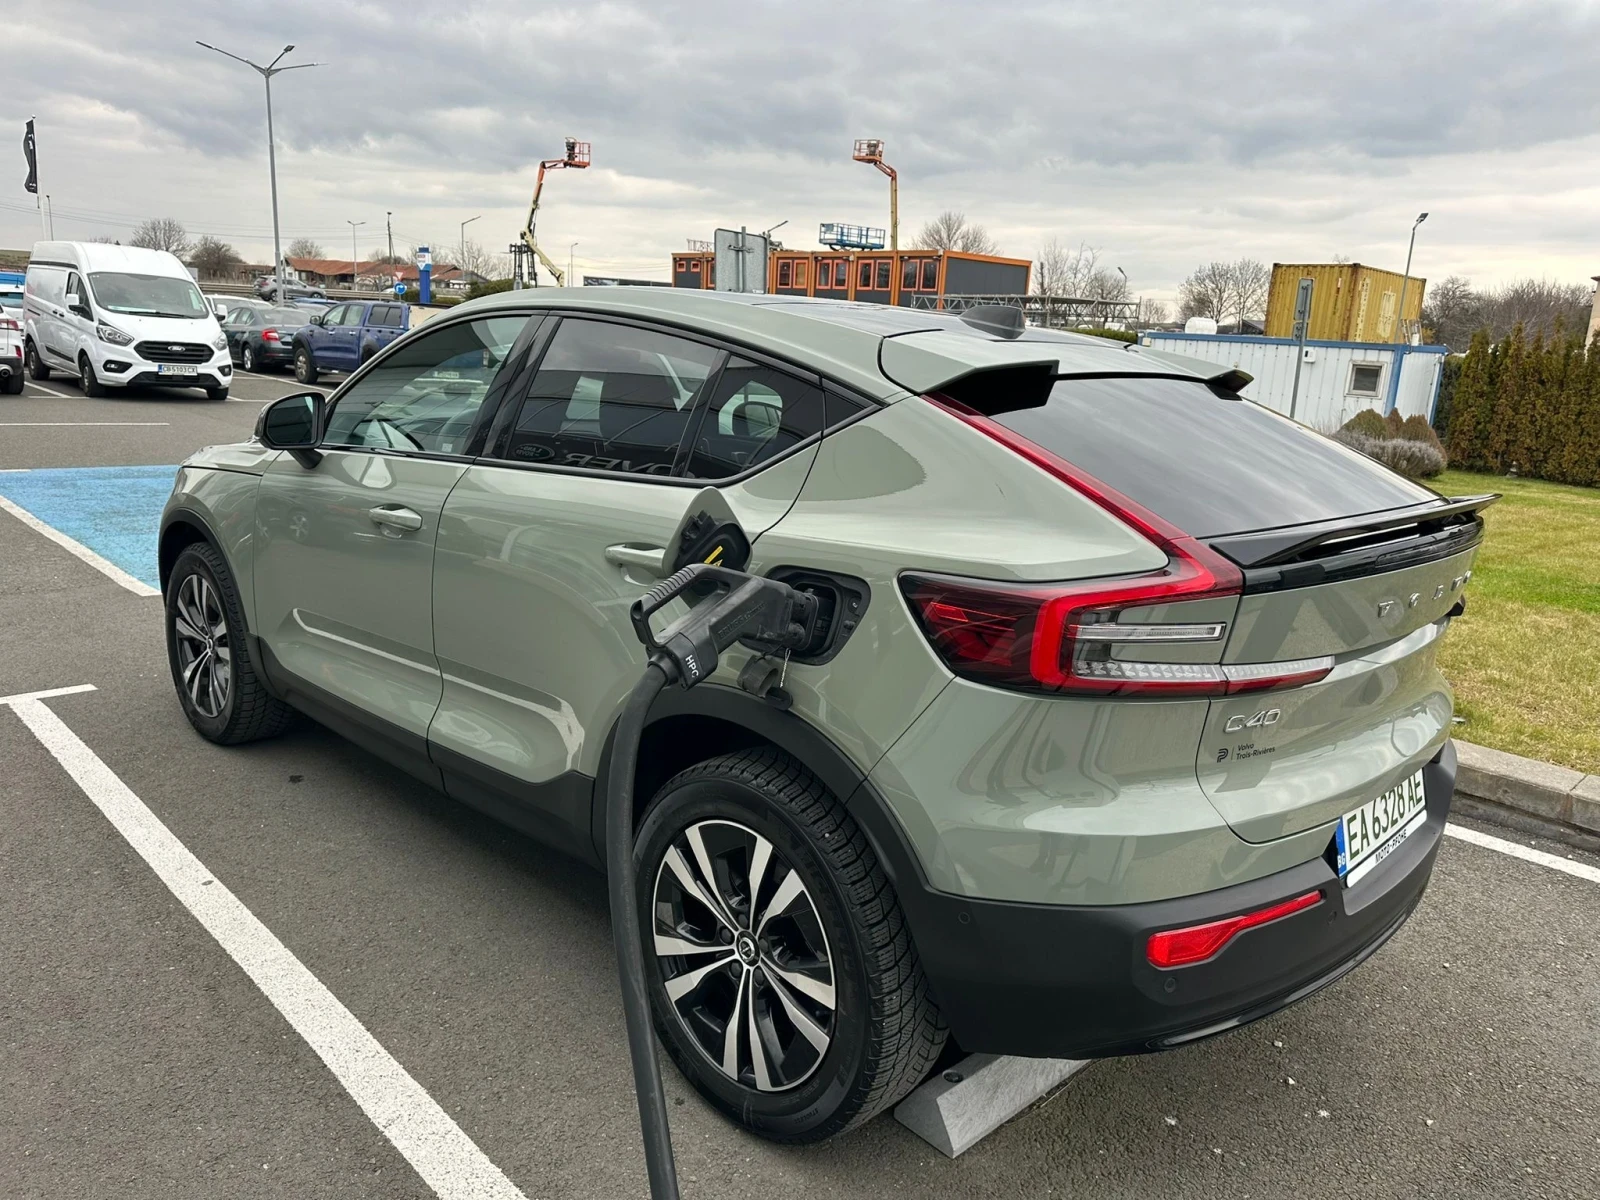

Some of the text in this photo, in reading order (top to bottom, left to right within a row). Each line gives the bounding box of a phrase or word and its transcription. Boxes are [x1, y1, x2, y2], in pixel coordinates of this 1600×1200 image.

[684, 653, 700, 678] HPC
[1224, 708, 1280, 734] C40
[1237, 743, 1255, 752] Volvo
[1347, 773, 1423, 862] EA 6328 AE
[1337, 852, 1346, 869] BG
